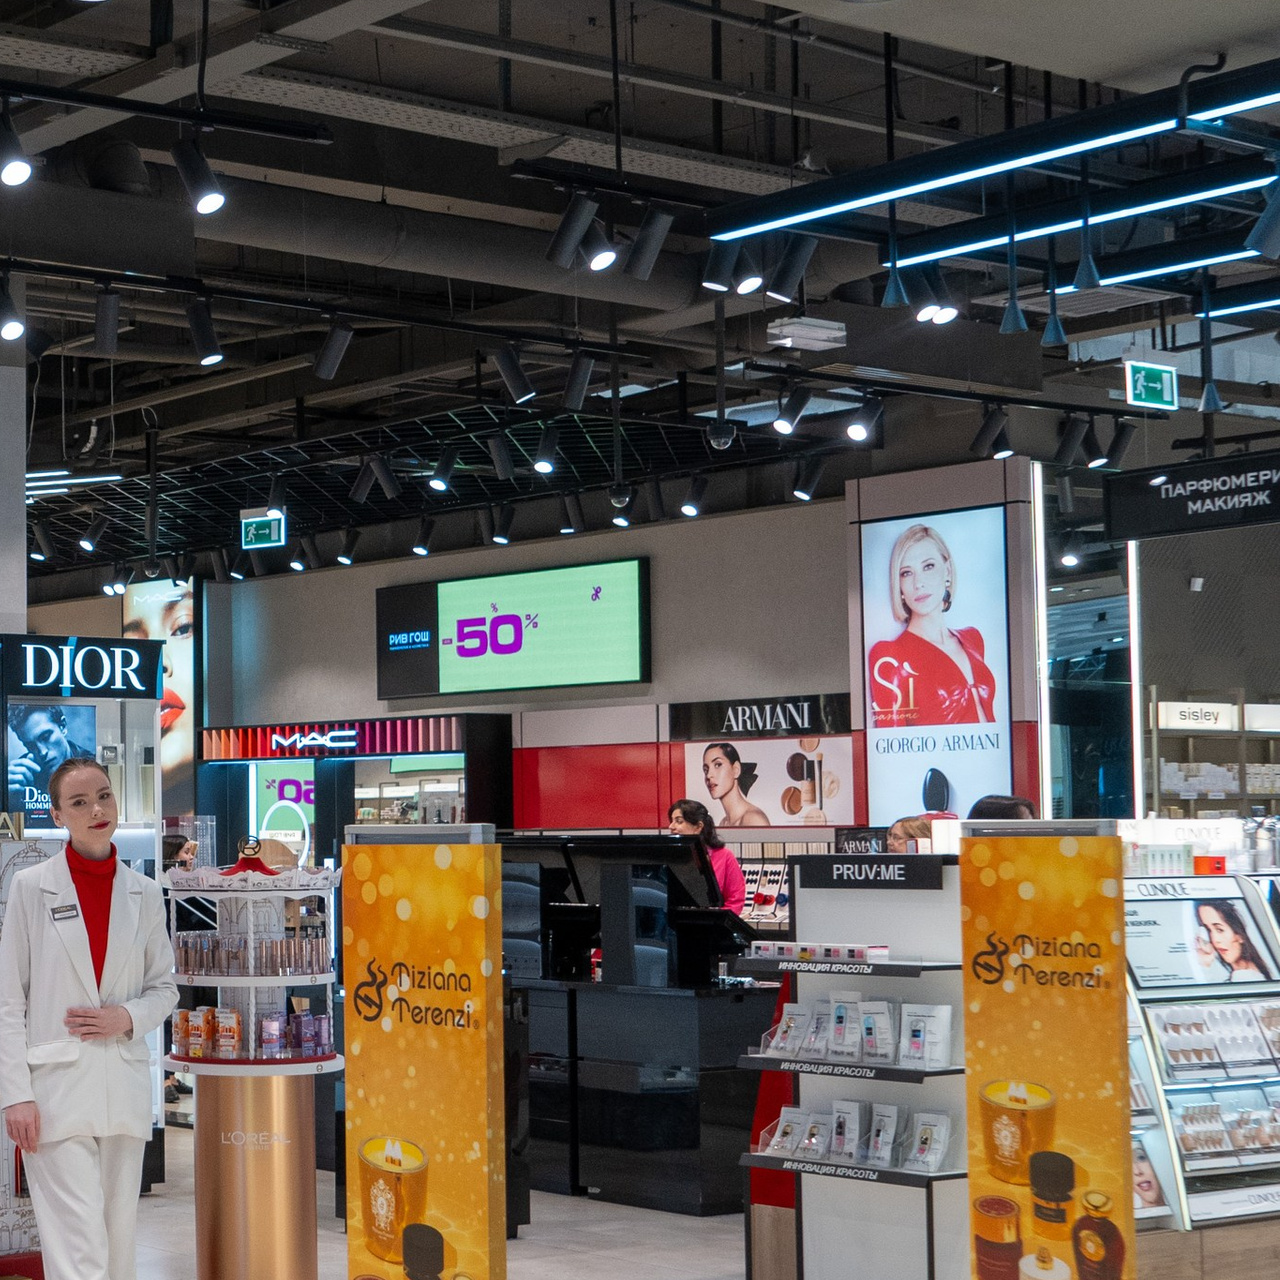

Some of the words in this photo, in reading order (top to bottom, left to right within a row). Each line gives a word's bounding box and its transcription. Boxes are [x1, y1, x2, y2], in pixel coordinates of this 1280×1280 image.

[1187, 490, 1272, 515] МАКИЯЖ
[389, 633, 407, 646] РИВ
[409, 631, 429, 644] ГОШ
[21, 644, 146, 691] DIOR
[721, 702, 811, 733] ARMANI
[1179, 707, 1220, 724] sisley
[271, 730, 358, 750] MAC
[876, 735, 936, 755] GIORGIO
[942, 733, 1001, 752] ARMANI
[842, 840, 883, 854] ARMANI
[833, 864, 906, 880] PRUV:ME
[1138, 883, 1190, 898] CLINIQUE
[1013, 934, 1101, 959] Tiziana
[391, 962, 471, 992] Tiziana
[778, 961, 830, 972] ИННОВАЦИЯ
[830, 962, 873, 974] КРАСОТЫ
[1014, 963, 1102, 989] Terenzi
[391, 997, 471, 1029] Terenzi
[780, 1061, 832, 1074] ИННОВАЦИЯ
[832, 1065, 875, 1077] КРАСОТЫ
[782, 1160, 835, 1175] ИННОВАЦИЯ
[835, 1166, 878, 1180] КРАСОТЫ
